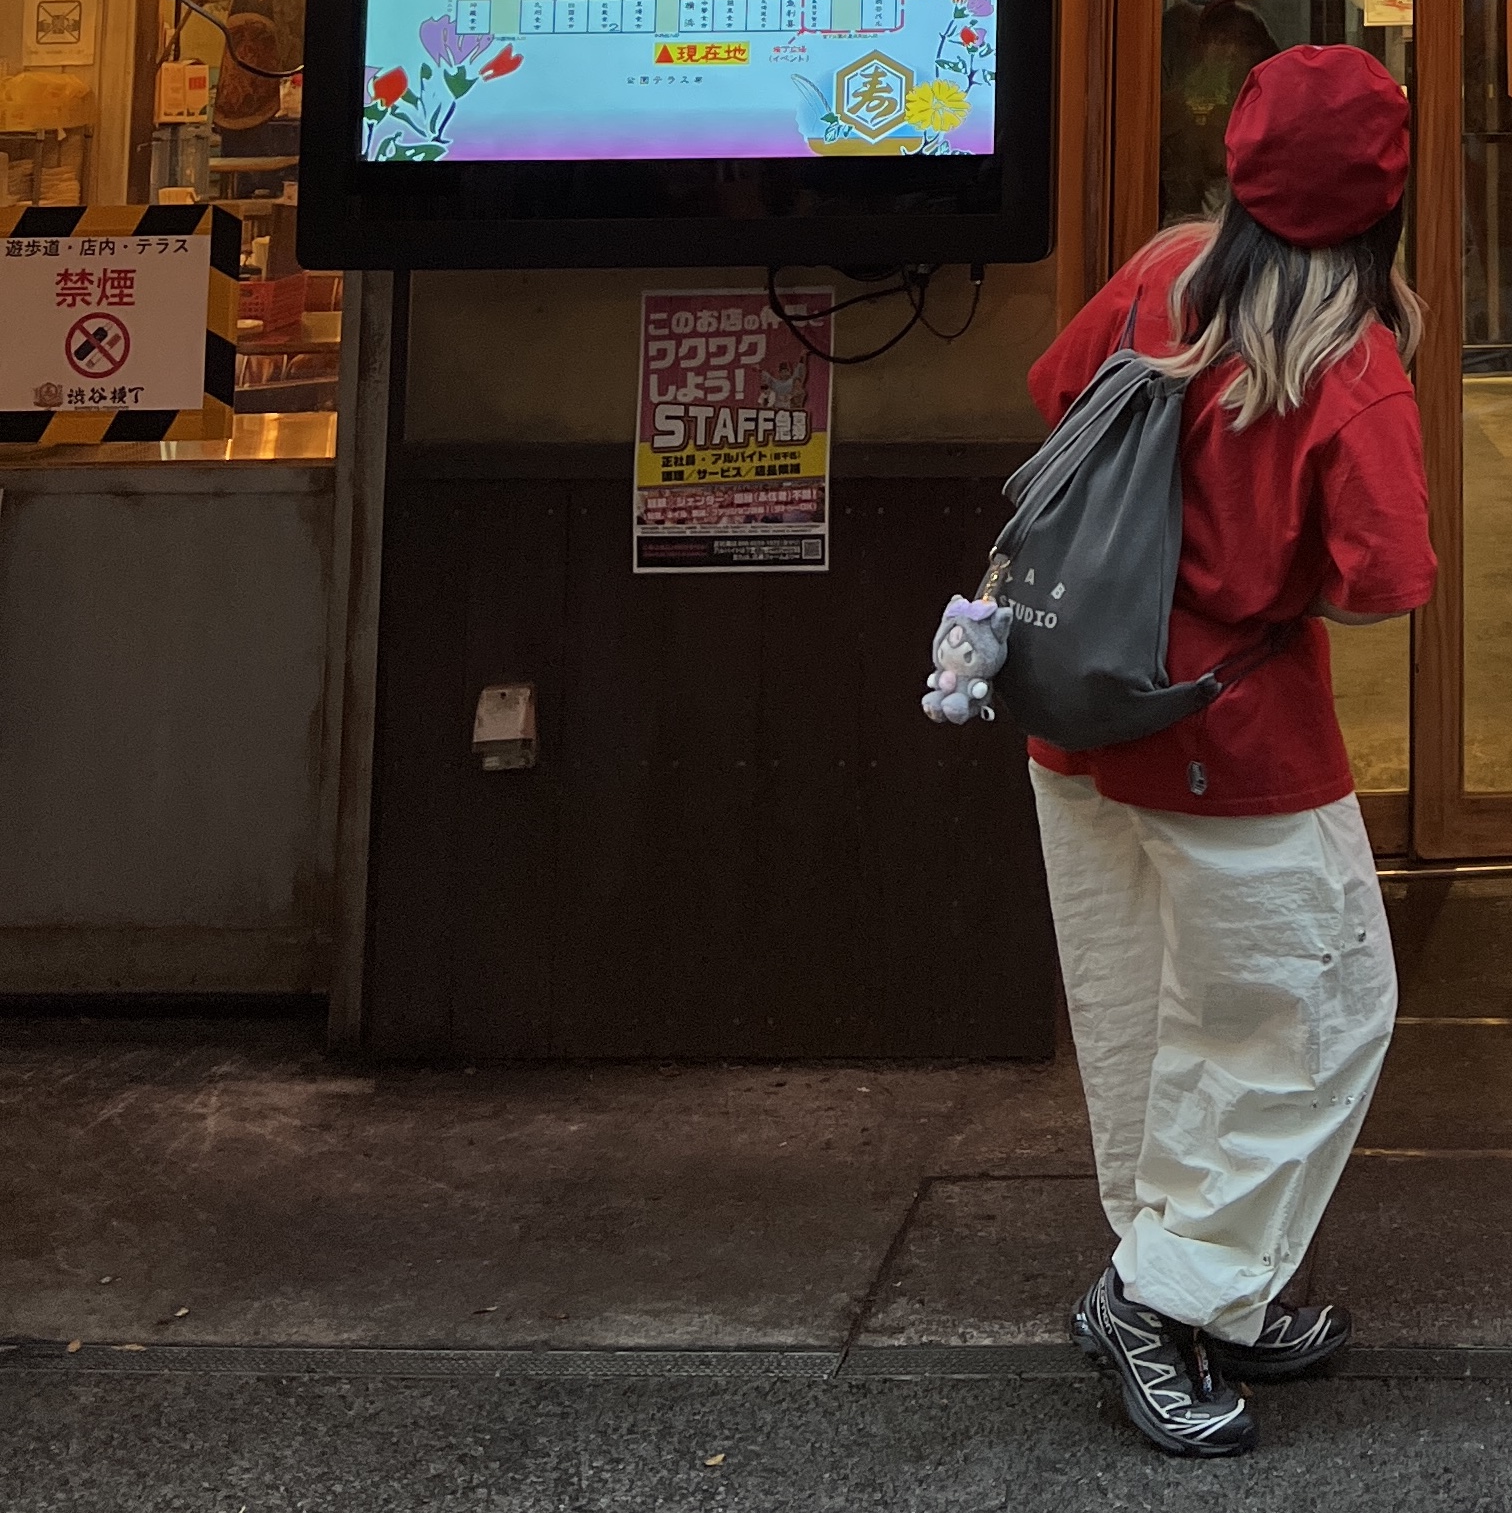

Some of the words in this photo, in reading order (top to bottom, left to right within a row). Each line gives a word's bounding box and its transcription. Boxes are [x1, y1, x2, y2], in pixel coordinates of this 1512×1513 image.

[676, 43, 747, 63] 現在地
[847, 66, 900, 123] 寿
[5, 237, 190, 257] 遊歩道・店内・テラス
[55, 268, 137, 308] 禁煙
[648, 335, 766, 369] ワクワク
[67, 386, 145, 406] 渋谷横丁
